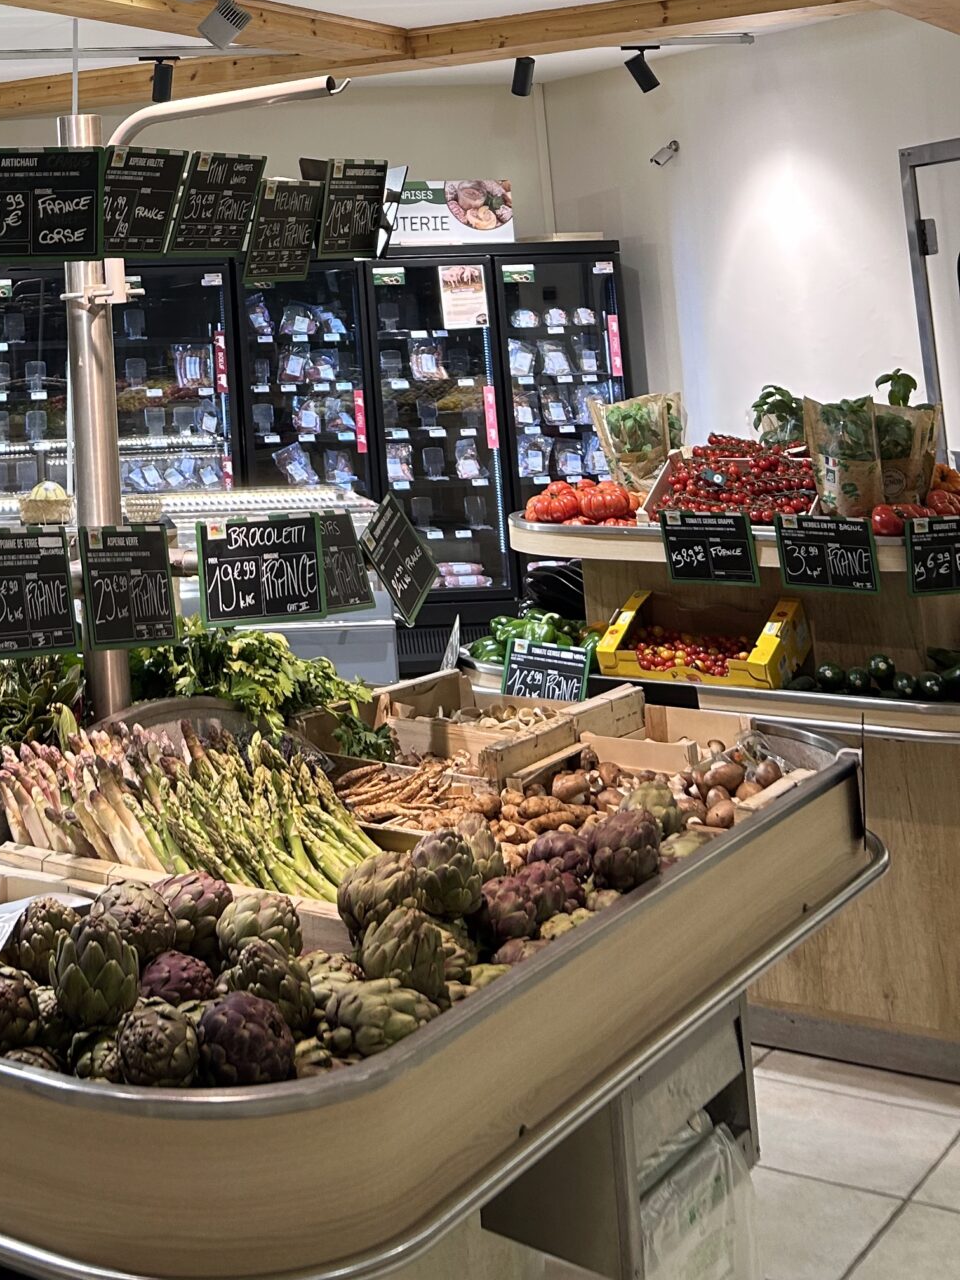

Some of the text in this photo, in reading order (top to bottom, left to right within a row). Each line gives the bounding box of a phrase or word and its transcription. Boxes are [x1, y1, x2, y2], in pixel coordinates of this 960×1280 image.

[1, 158, 38, 167] ARTICHAUT
[38, 195, 93, 218] FRANCE
[135, 206, 165, 220] FRANCE
[217, 197, 251, 221] FRANCE
[38, 228, 87, 244] CORSE
[802, 521, 820, 529] HERBES
[0, 538, 38, 549] POMME DE TERRE
[107, 537, 139, 546] ASPERGE VERTE
[227, 524, 306, 550] BROCOLETTI
[827, 547, 870, 576] FRANCE
[261, 553, 318, 601] FRANCE
[26, 580, 68, 621] FRANCE
[129, 573, 169, 617] FRANCE
[545, 674, 582, 702] FRANCE
